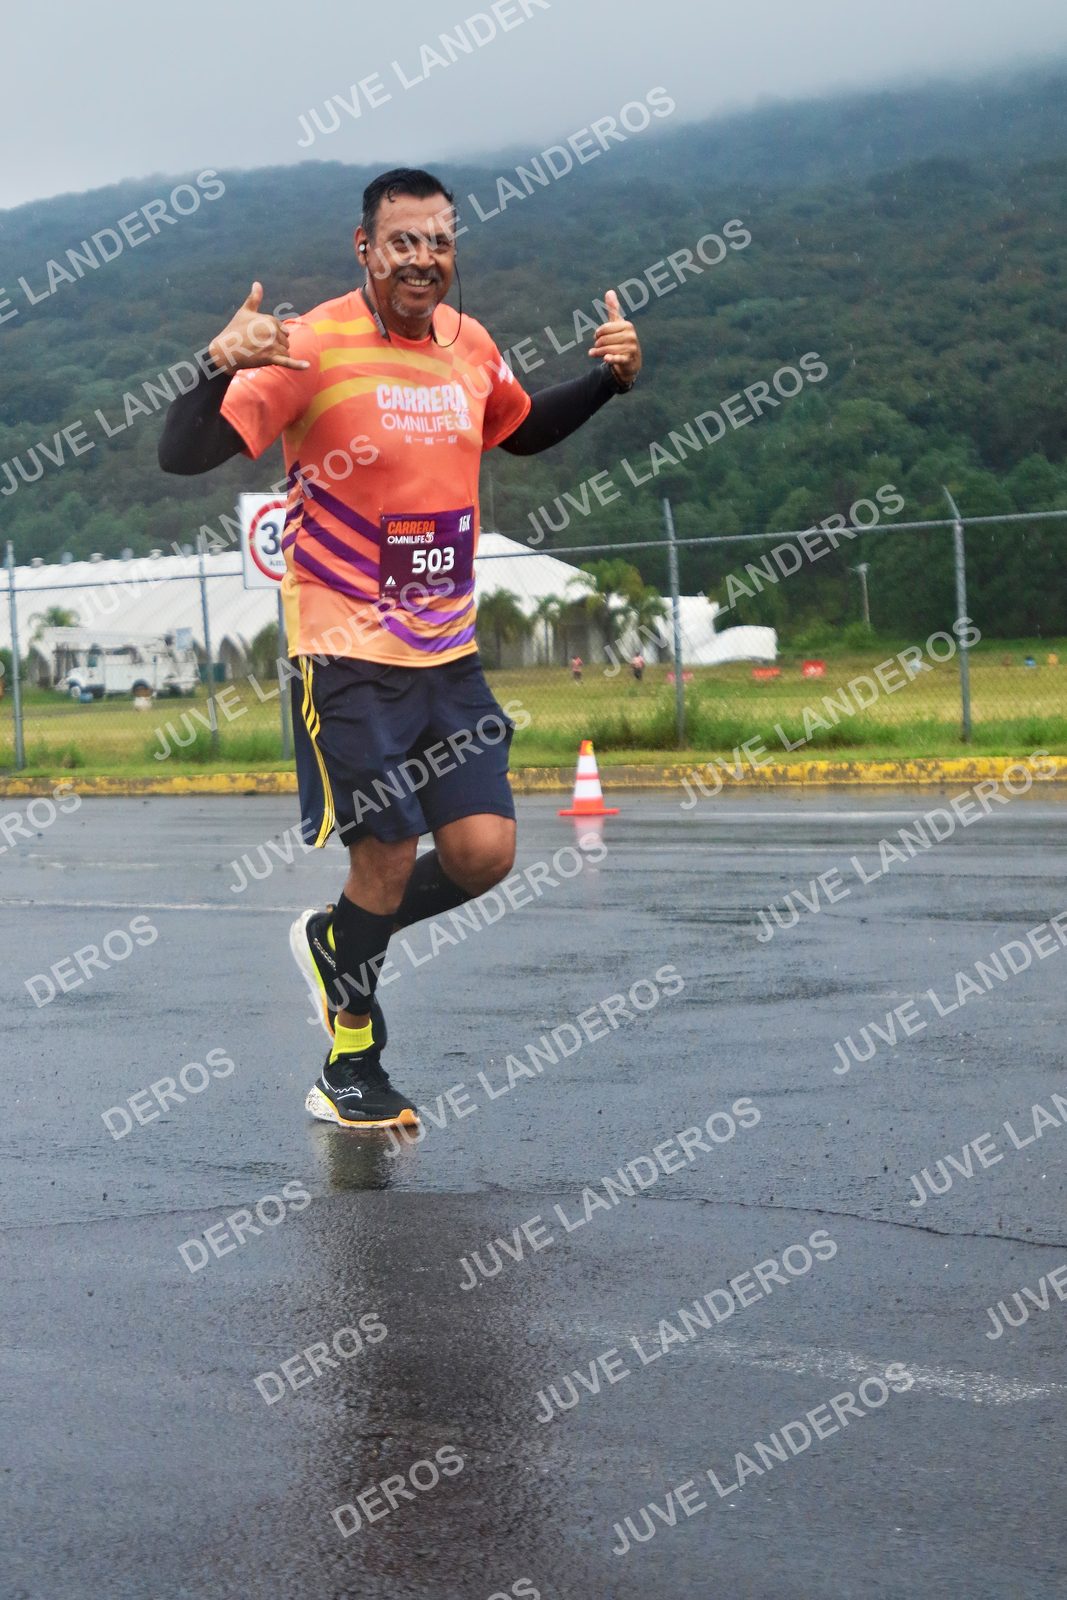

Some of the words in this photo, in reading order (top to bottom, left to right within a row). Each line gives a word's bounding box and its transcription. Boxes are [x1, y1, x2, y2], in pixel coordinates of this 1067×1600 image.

[377, 384, 467, 413] CARRERA
[381, 412, 454, 432] OMNILIFE
[261, 522, 281, 555] 3
[387, 521, 435, 534] CARRERA
[387, 534, 424, 544] OMNILIFE
[412, 547, 454, 574] 503
